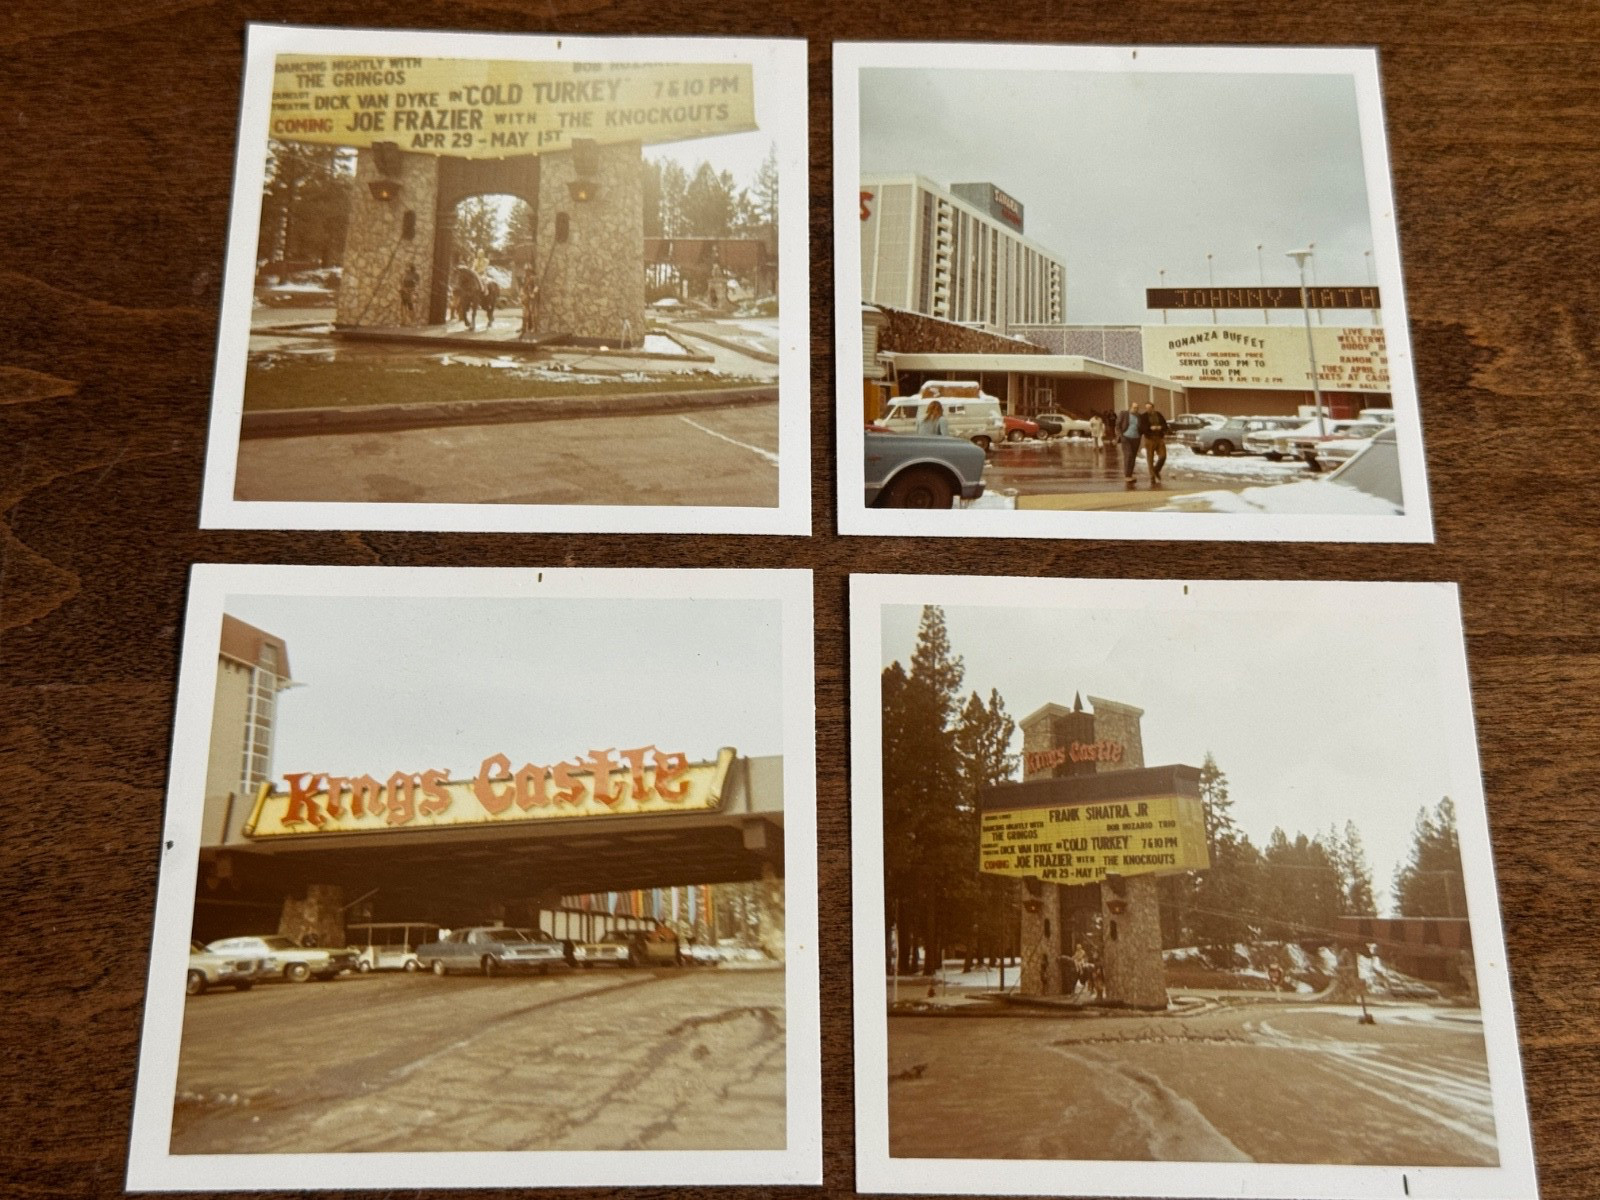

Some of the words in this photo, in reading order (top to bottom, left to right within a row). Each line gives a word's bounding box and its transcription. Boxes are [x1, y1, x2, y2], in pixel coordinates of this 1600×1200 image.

[275, 62, 327, 72] DANCING
[331, 59, 384, 70] NIGHTLY
[389, 57, 421, 68] WITH
[297, 74, 325, 88] THE
[333, 71, 406, 87] GRINGOS
[315, 95, 350, 110] DICK
[357, 94, 389, 109] VAN
[396, 91, 439, 108] DYKE
[449, 91, 462, 102] IN
[654, 81, 664, 99] 7
[709, 74, 739, 95] PM
[273, 118, 334, 134] COMING
[346, 111, 386, 132] JOE
[393, 109, 483, 131] FRAZIER
[494, 111, 537, 124] WITH
[558, 111, 593, 128] THE
[606, 103, 729, 126] KNOCKOUTS
[411, 133, 446, 148] APR
[452, 132, 473, 148] 29
[491, 131, 529, 147] MAY
[1174, 289, 1282, 308] JOHNNY
[1168, 331, 1218, 350] BONANZA
[1222, 331, 1265, 349] BUFFET
[1236, 359, 1249, 367] PM
[1254, 359, 1265, 367] TO
[1322, 365, 1344, 373] TUES
[1350, 366, 1374, 374] APRIL
[1228, 368, 1241, 376] PM
[1069, 741, 1122, 762] Castle
[281, 767, 451, 827] Kings
[473, 745, 689, 816] Castle
[1049, 808, 1080, 823] FRANK
[1086, 803, 1131, 820] SINATRA
[1135, 802, 1148, 817] JR
[1158, 820, 1176, 828] TRIO
[992, 832, 1004, 841] THE
[1007, 830, 1038, 840] GRINGOS
[1000, 845, 1016, 855] DICK
[1017, 844, 1031, 853] VAN
[1034, 843, 1053, 853] DYKE
[1164, 837, 1178, 848] PM
[984, 860, 1010, 869] COMING
[1014, 855, 1031, 868] JOE
[1034, 854, 1072, 868] FRAZIER
[1103, 855, 1119, 865] THE
[1123, 854, 1175, 865] KNOCKOUTS
[1042, 869, 1057, 878] APR
[1059, 868, 1069, 878] 29
[1075, 867, 1092, 878] MAY
